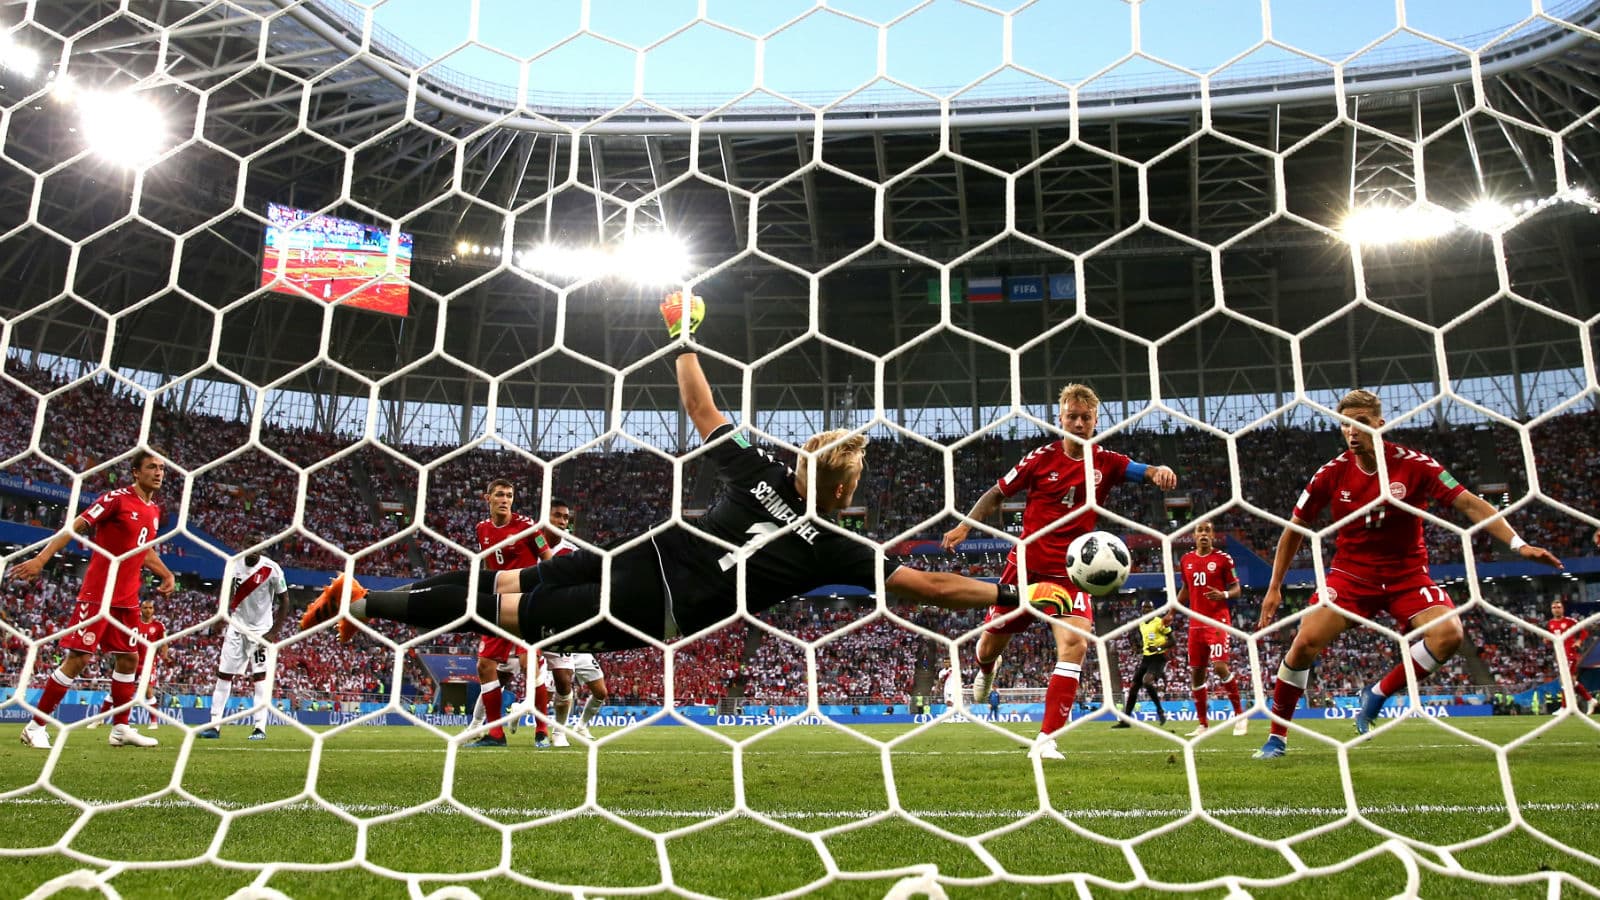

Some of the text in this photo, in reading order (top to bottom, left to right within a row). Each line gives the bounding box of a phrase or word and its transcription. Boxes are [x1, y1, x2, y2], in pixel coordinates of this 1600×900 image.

[1013, 285, 1037, 294] FIFA
[1061, 486, 1076, 508] 4
[137, 526, 148, 547] 8
[977, 542, 994, 550] FIFA
[495, 548, 504, 565] 6
[1193, 571, 1207, 587] 20
[1073, 591, 1087, 612] 4
[1419, 585, 1445, 603] 17
[128, 627, 139, 647] 8
[254, 650, 266, 664] 15
[1210, 643, 1223, 659] 20
[137, 706, 184, 724] WNDA
[440, 714, 469, 726] WANDA
[738, 714, 773, 726] 万达
[772, 714, 832, 727] WND
[974, 712, 1033, 723] WANDA
